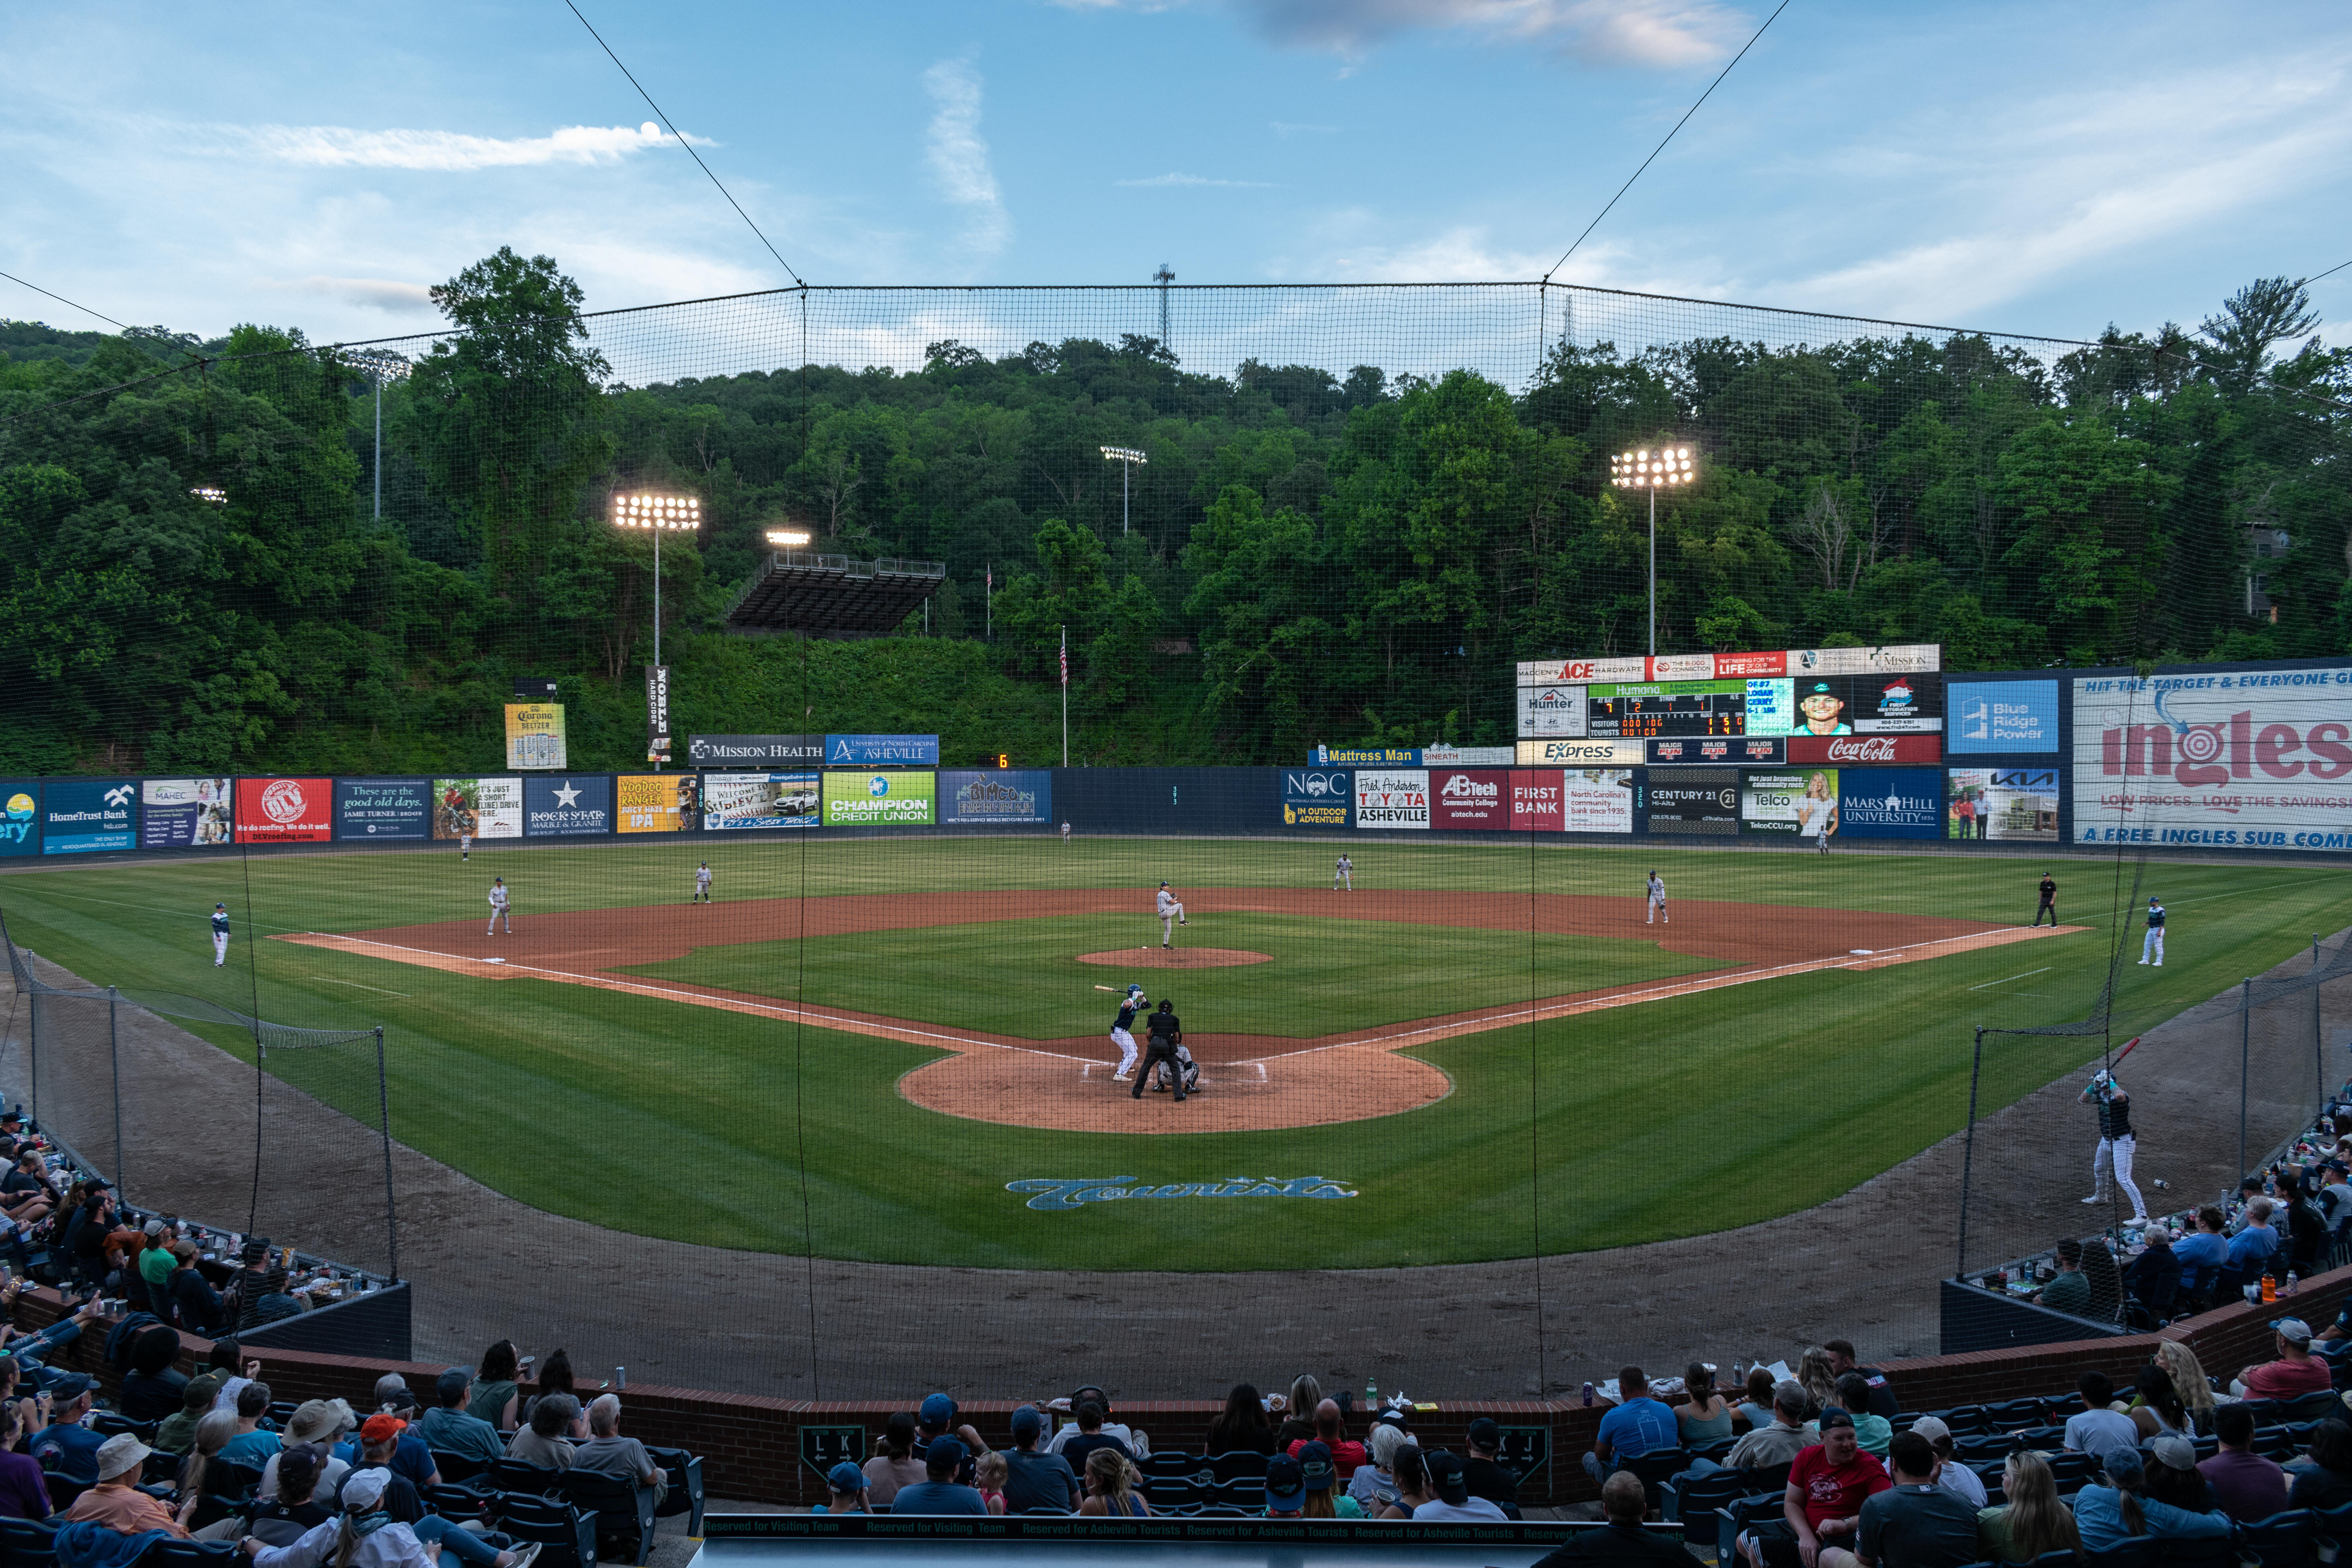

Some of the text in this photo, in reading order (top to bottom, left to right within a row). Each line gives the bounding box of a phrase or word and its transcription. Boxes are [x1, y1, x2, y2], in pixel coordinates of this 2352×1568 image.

[1884, 656, 1928, 666] MISSION
[1557, 661, 1595, 680] ACE
[1719, 664, 1745, 675] LIFE
[2085, 680, 2113, 692] HIT
[2118, 680, 2147, 691] THE
[2153, 676, 2215, 690] TARGET
[2220, 676, 2233, 688] &
[2238, 672, 2330, 687] EVERYONE
[1616, 685, 1660, 695] Humana
[657, 669, 667, 733] NOBLE
[1529, 699, 1573, 709] Hunter
[1635, 703, 1641, 713] 2
[1993, 703, 2028, 714] Blue
[518, 711, 553, 722] Corona
[1993, 716, 2038, 729] Ridge
[1993, 729, 2044, 740] Power
[712, 745, 823, 757] MISSION HEALTH
[863, 748, 925, 759] ASHEVILLE
[1545, 742, 1613, 762] Express
[1828, 738, 1898, 761] Coca-Cola
[2101, 709, 2352, 788] ingles
[1330, 749, 1412, 761] Mattress Man
[352, 787, 380, 795] These
[399, 787, 414, 795] the
[621, 781, 662, 793] VOODOO
[969, 781, 1018, 801] BIMCO
[1287, 773, 1346, 797] NOC
[1359, 777, 1425, 793] Fred Anderson
[1514, 787, 1557, 799] FIRST
[1651, 791, 1717, 800] CENTURY 21
[344, 797, 422, 809] good old days.
[621, 793, 663, 806] RANGER
[831, 799, 928, 811] CHAMPION
[1442, 799, 1498, 807] Community College
[1753, 793, 1790, 806] Telco
[1844, 796, 1936, 810] MARS HILL
[2101, 795, 2135, 806] LOW
[2203, 795, 2242, 807] LOVE
[2244, 796, 2275, 807] THE
[1515, 801, 1558, 814] BANK
[49, 810, 127, 822] HomeTrust Bank
[631, 814, 654, 828] IPA
[831, 811, 928, 821] CREDIT UNION
[1359, 810, 1427, 822] ASHEVILLE
[1846, 811, 1921, 822] UNIVERSITY
[1750, 822, 1797, 831] TelcoCCU.org
[2082, 828, 2097, 841] A
[2103, 828, 2154, 842] FREE
[2160, 829, 2237, 844] INGLES
[2243, 830, 2287, 846] SUB
[1004, 1174, 1360, 1211] Tourists
[816, 1435, 850, 1451] L K
[703, 1521, 839, 1533] Reserved for Visiting Team
[867, 1521, 1005, 1535] Reserved for Visiting Team
[1023, 1523, 1180, 1535] Reserved for Asheville Tourists
[1187, 1525, 1348, 1537] Reserved for Asheville Tourists
[1355, 1527, 1514, 1539] Reserved for Asheville Tourists
[1524, 1529, 1573, 1539] Reserved
